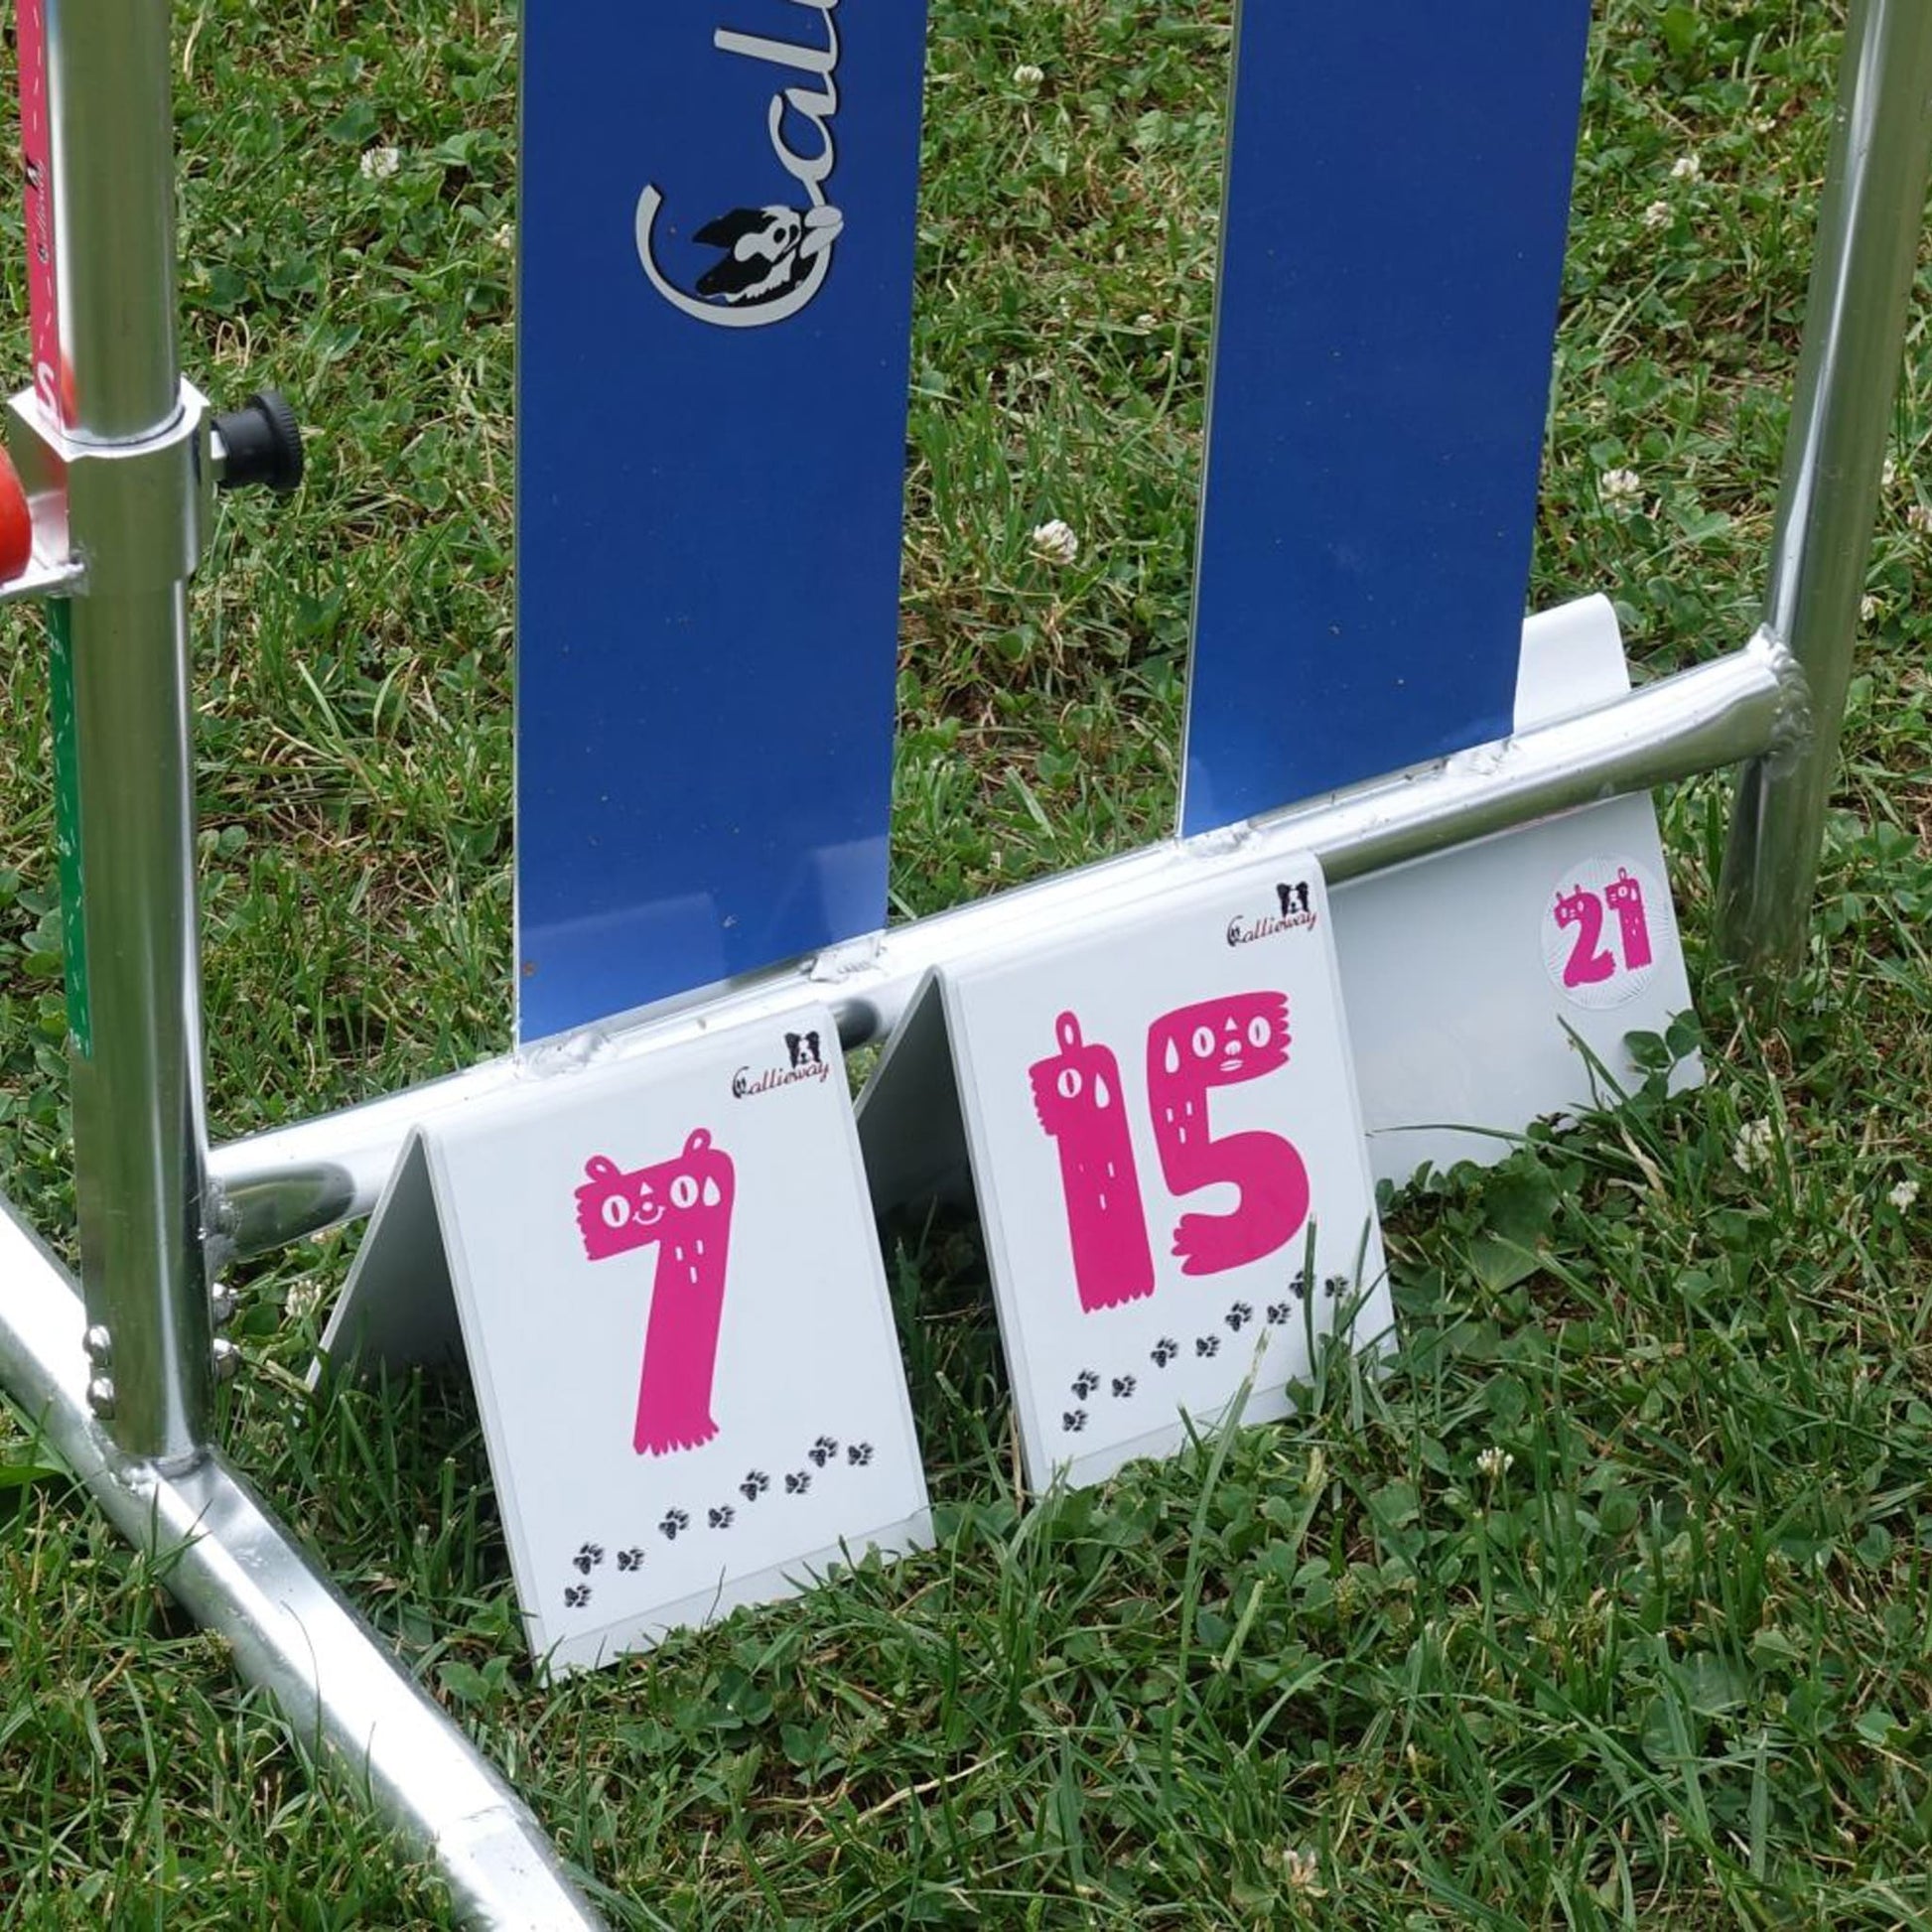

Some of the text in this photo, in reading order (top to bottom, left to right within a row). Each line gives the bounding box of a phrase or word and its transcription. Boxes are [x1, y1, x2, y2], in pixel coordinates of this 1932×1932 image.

[633, 0, 844, 328] Cal
[1554, 867, 1652, 988] 21
[574, 1128, 735, 1457] 7
[1029, 990, 1310, 1314] 15
